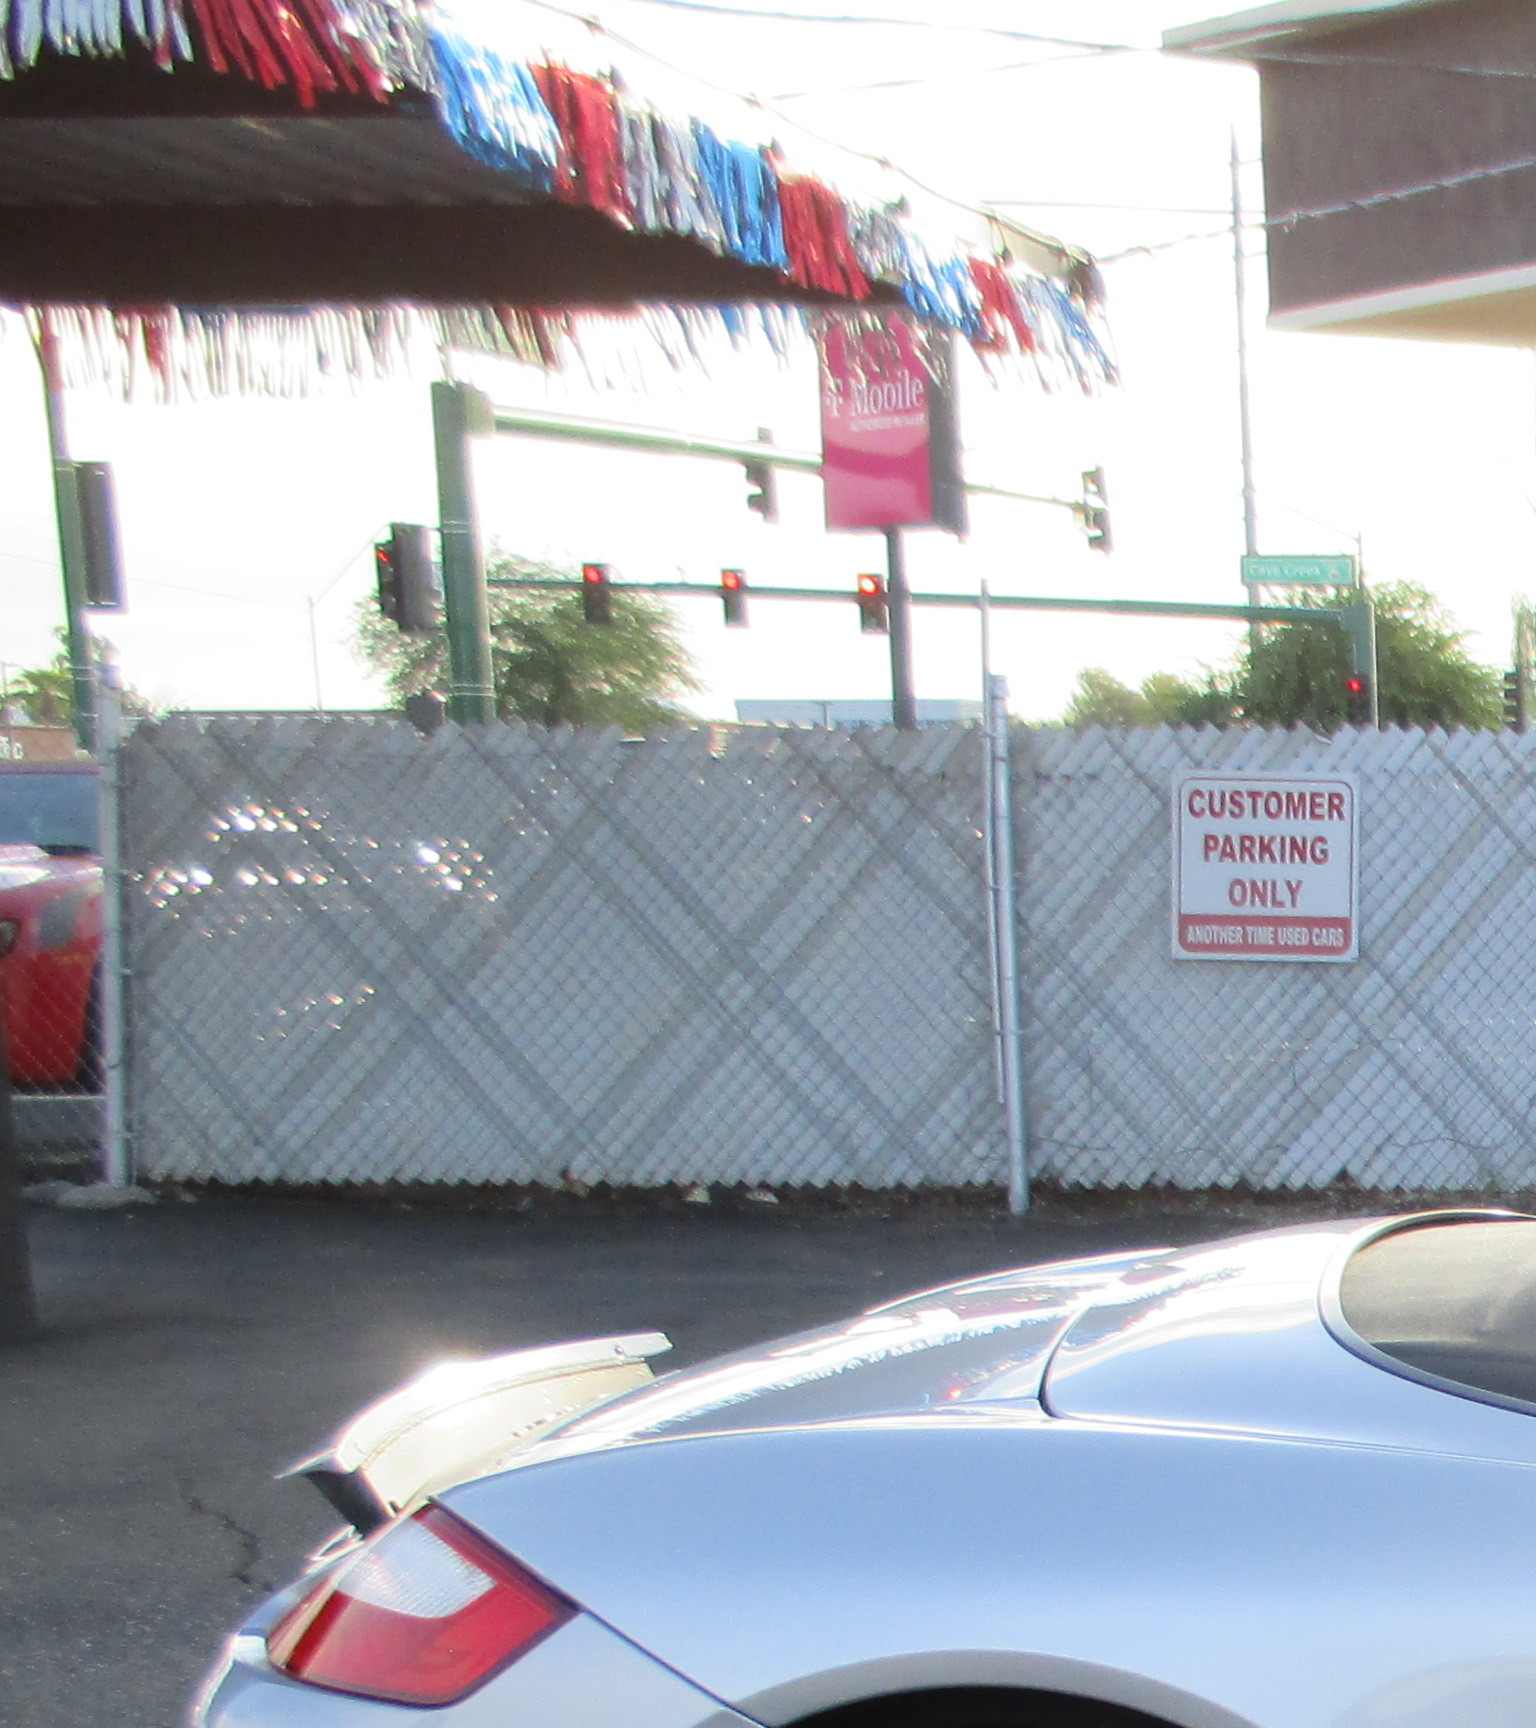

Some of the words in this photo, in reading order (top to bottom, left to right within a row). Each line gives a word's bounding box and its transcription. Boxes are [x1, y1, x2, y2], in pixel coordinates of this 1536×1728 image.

[1188, 789, 1346, 821] CUSTOMER
[1203, 834, 1329, 865] PARKING
[1228, 878, 1303, 908] ONLY
[1187, 925, 1243, 944] ANOTHER
[1246, 926, 1274, 945] TIME
[1278, 927, 1309, 946] USED
[1312, 928, 1344, 947] CARS
